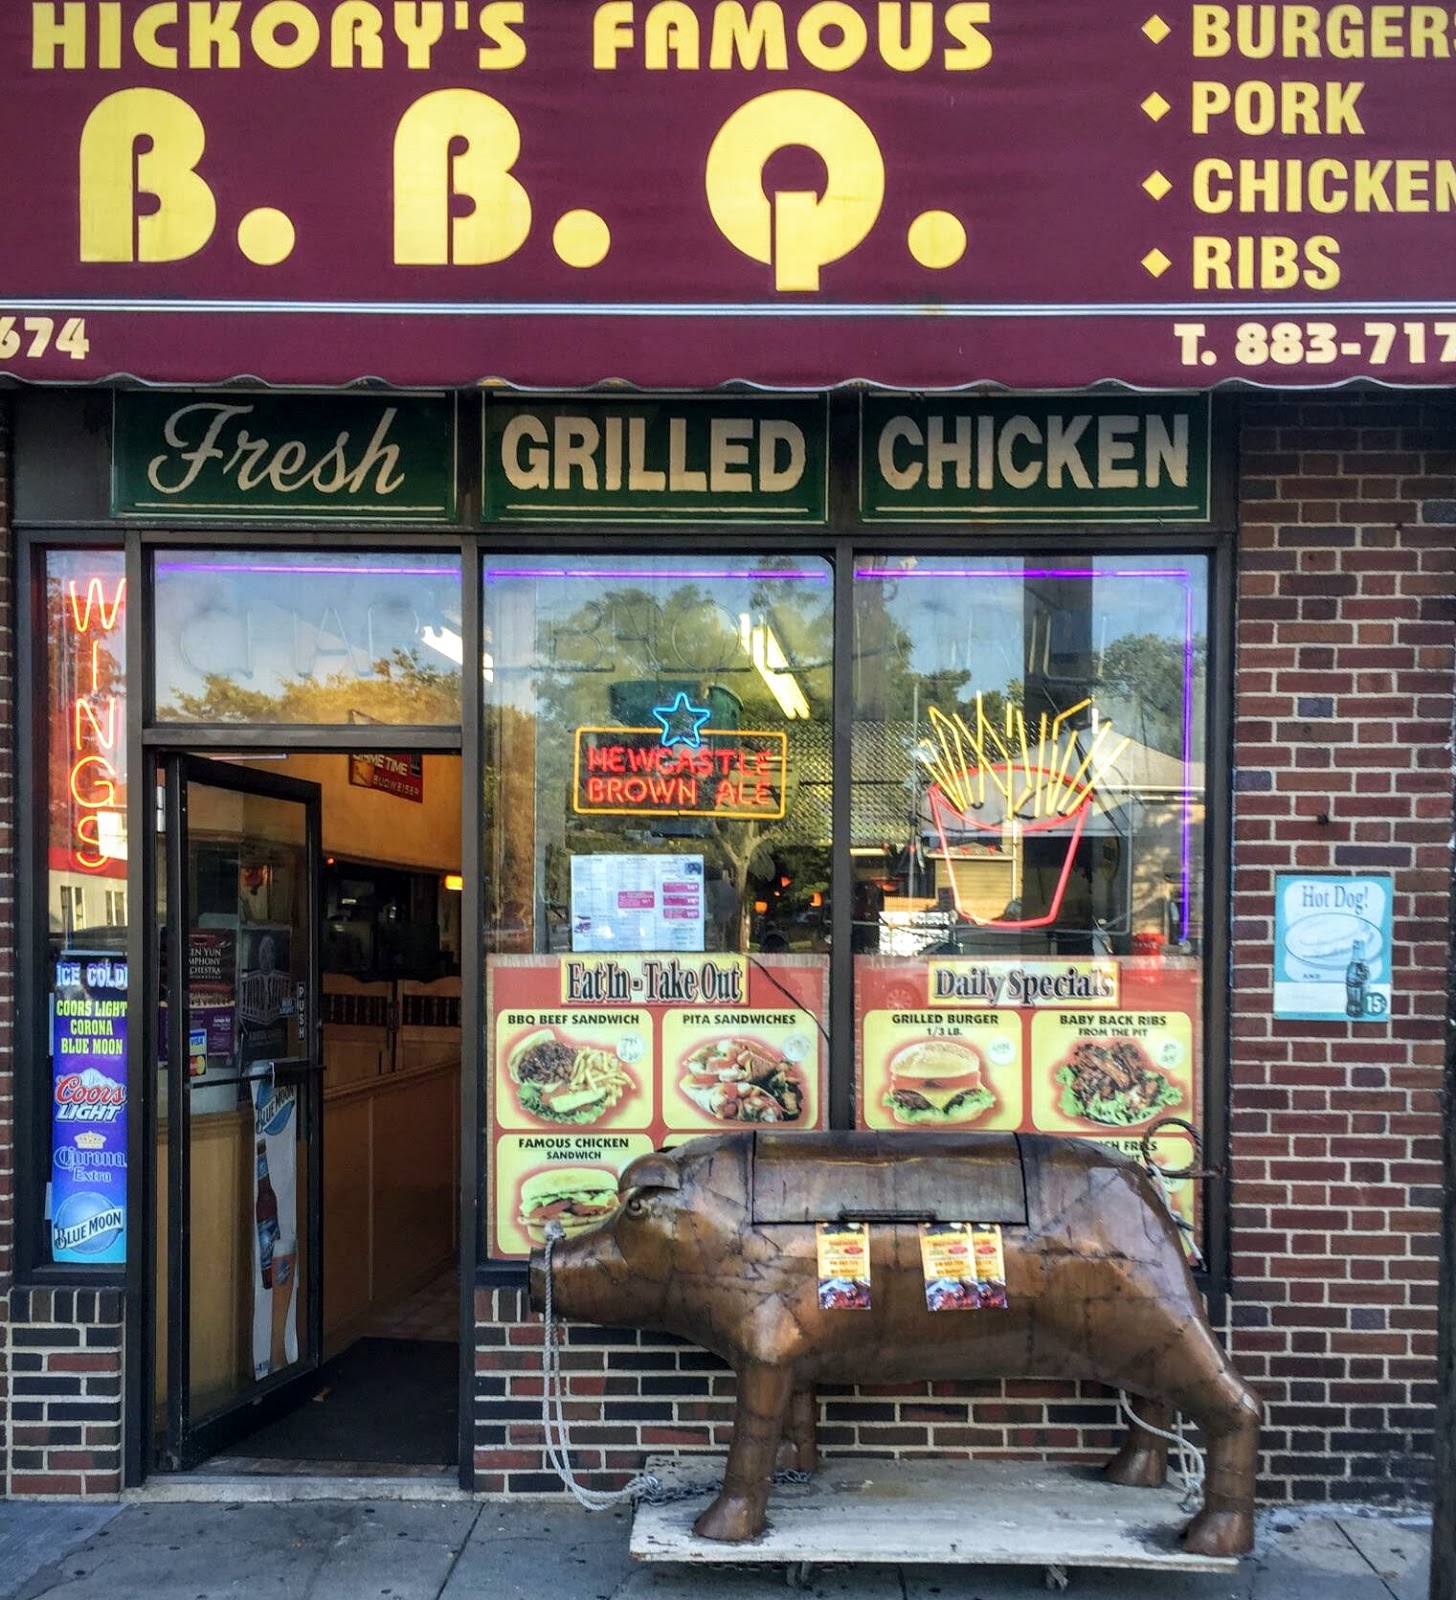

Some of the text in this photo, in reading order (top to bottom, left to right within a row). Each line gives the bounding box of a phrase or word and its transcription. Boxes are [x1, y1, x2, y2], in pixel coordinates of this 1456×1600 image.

[31, 0, 993, 71] HICKORY'S FAMOUS
[1192, 4, 1456, 58] BURGER
[1192, 80, 1365, 135] PORK
[1192, 235, 1341, 290] RIBS
[1174, 322, 1217, 365] T.
[147, 402, 1189, 494] Fresh GRILLED CHICKEN
[69, 577, 126, 868] WINGS
[586, 744, 773, 777] NEWCASTLE
[586, 776, 772, 807] BROWN ALE
[1301, 885, 1369, 915] Hot Dog!
[56, 962, 80, 987] ICE
[643, 959, 698, 1001] Take
[700, 961, 742, 1002] Out
[934, 967, 1113, 1008] Daily Specials
[56, 1000, 128, 1018] COORS LIGHT
[508, 1014, 640, 1025] BBQ BEEF SANDWICH
[682, 1014, 796, 1026] PITA SANDWICHES
[892, 1014, 999, 1025] GRILLED BURGER
[1060, 1015, 1167, 1027] BABY BACK RIBS
[70, 1018, 114, 1036] CORONA
[1079, 1027, 1148, 1037] FROM THE PIT
[61, 1037, 123, 1055] BLUE MOON
[56, 1073, 126, 1105] Coors
[56, 1103, 122, 1122] LIGHT
[518, 1138, 629, 1148] FAMOUS CHICKEN
[546, 1151, 601, 1160] SANDWICH
[53, 1146, 127, 1170] Corona
[73, 1166, 112, 1182] Extra
[88, 1210, 122, 1236] MOON
